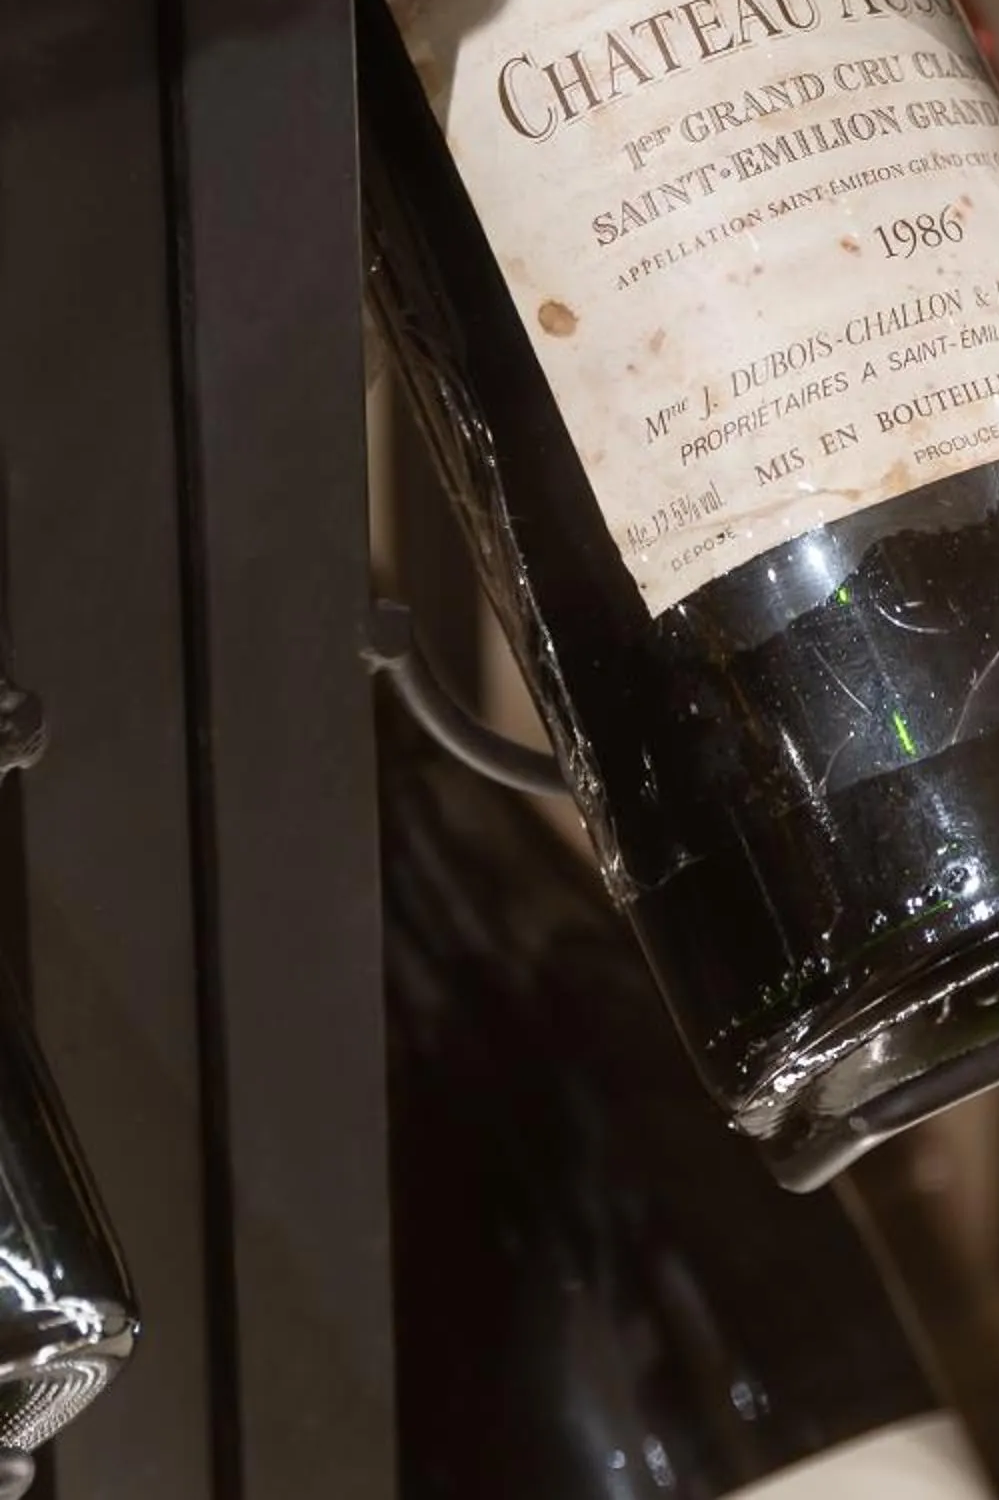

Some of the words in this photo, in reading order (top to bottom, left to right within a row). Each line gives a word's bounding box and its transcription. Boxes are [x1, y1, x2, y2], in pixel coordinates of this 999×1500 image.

[680, 71, 826, 144] GRAND
[833, 54, 904, 91] CRU
[905, 99, 999, 130] GRAND
[617, 208, 763, 290] APPELLATION
[908, 152, 963, 174] GRAND
[873, 202, 964, 259] 1986
[699, 385, 718, 421] J.
[973, 286, 990, 308] &
[680, 371, 849, 467] PROPRIÉTAIRES
[861, 361, 878, 384] A
[753, 446, 806, 488] MIS
[818, 423, 861, 456] EN
